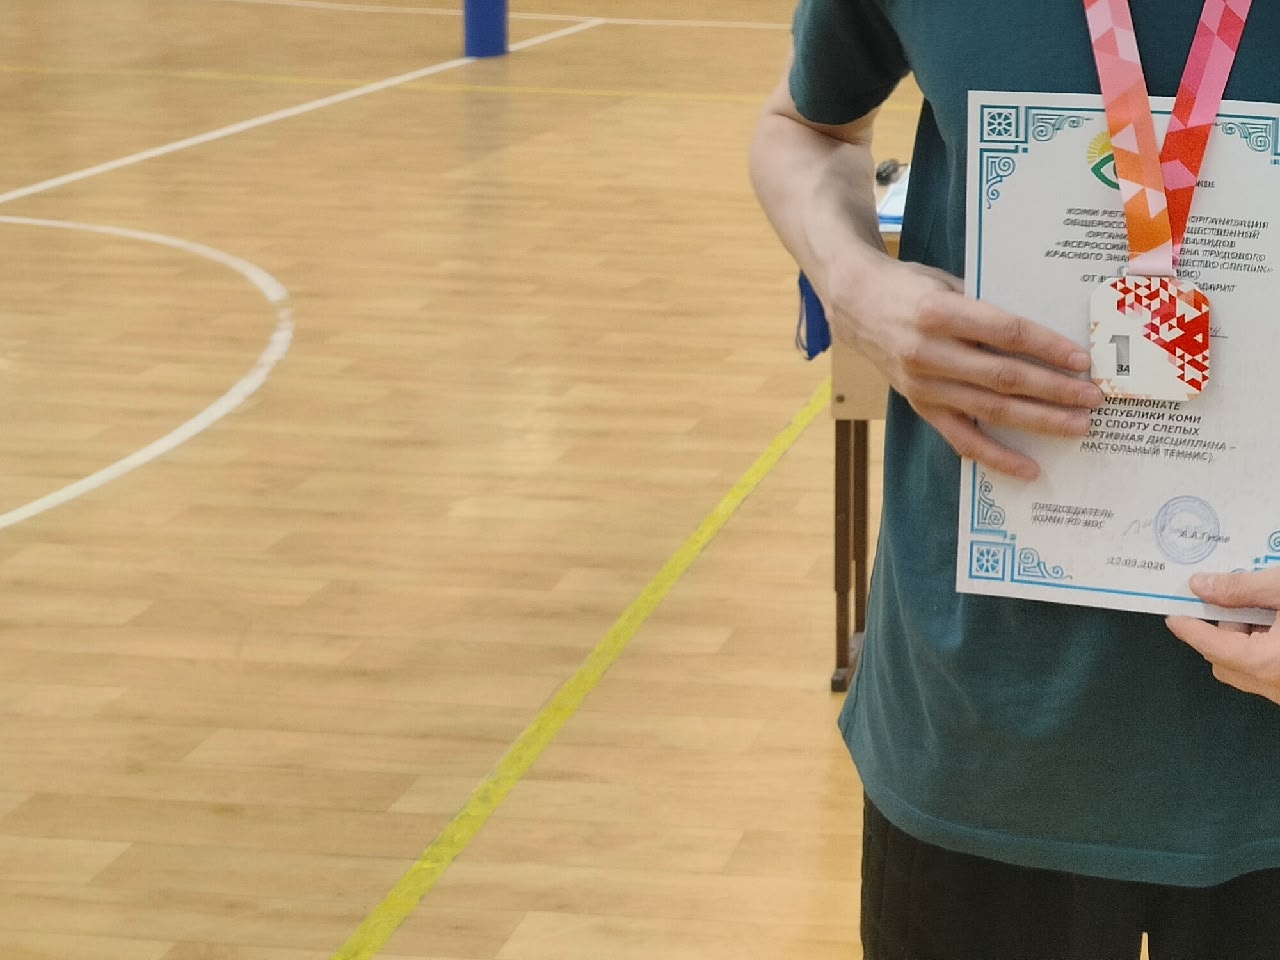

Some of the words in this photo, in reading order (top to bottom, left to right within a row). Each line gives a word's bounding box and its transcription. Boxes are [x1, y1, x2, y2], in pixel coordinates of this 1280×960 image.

[1044, 250, 1103, 261] КРАСНОГО
[1109, 335, 1130, 377] 1
[1116, 364, 1131, 373] ЗА
[1104, 396, 1181, 411] ЧЕМПИОНАТЕ
[1090, 407, 1165, 421] РЕСПУБЛИКИ
[1168, 413, 1202, 425] КОМИ
[1105, 419, 1150, 432] СПОРТУ
[1152, 424, 1200, 436] СЛЕПЫХ
[1080, 441, 1160, 456] НАСТОЛЬНЫЙ
[1146, 435, 1227, 451] ДИСЦИПЛИНА
